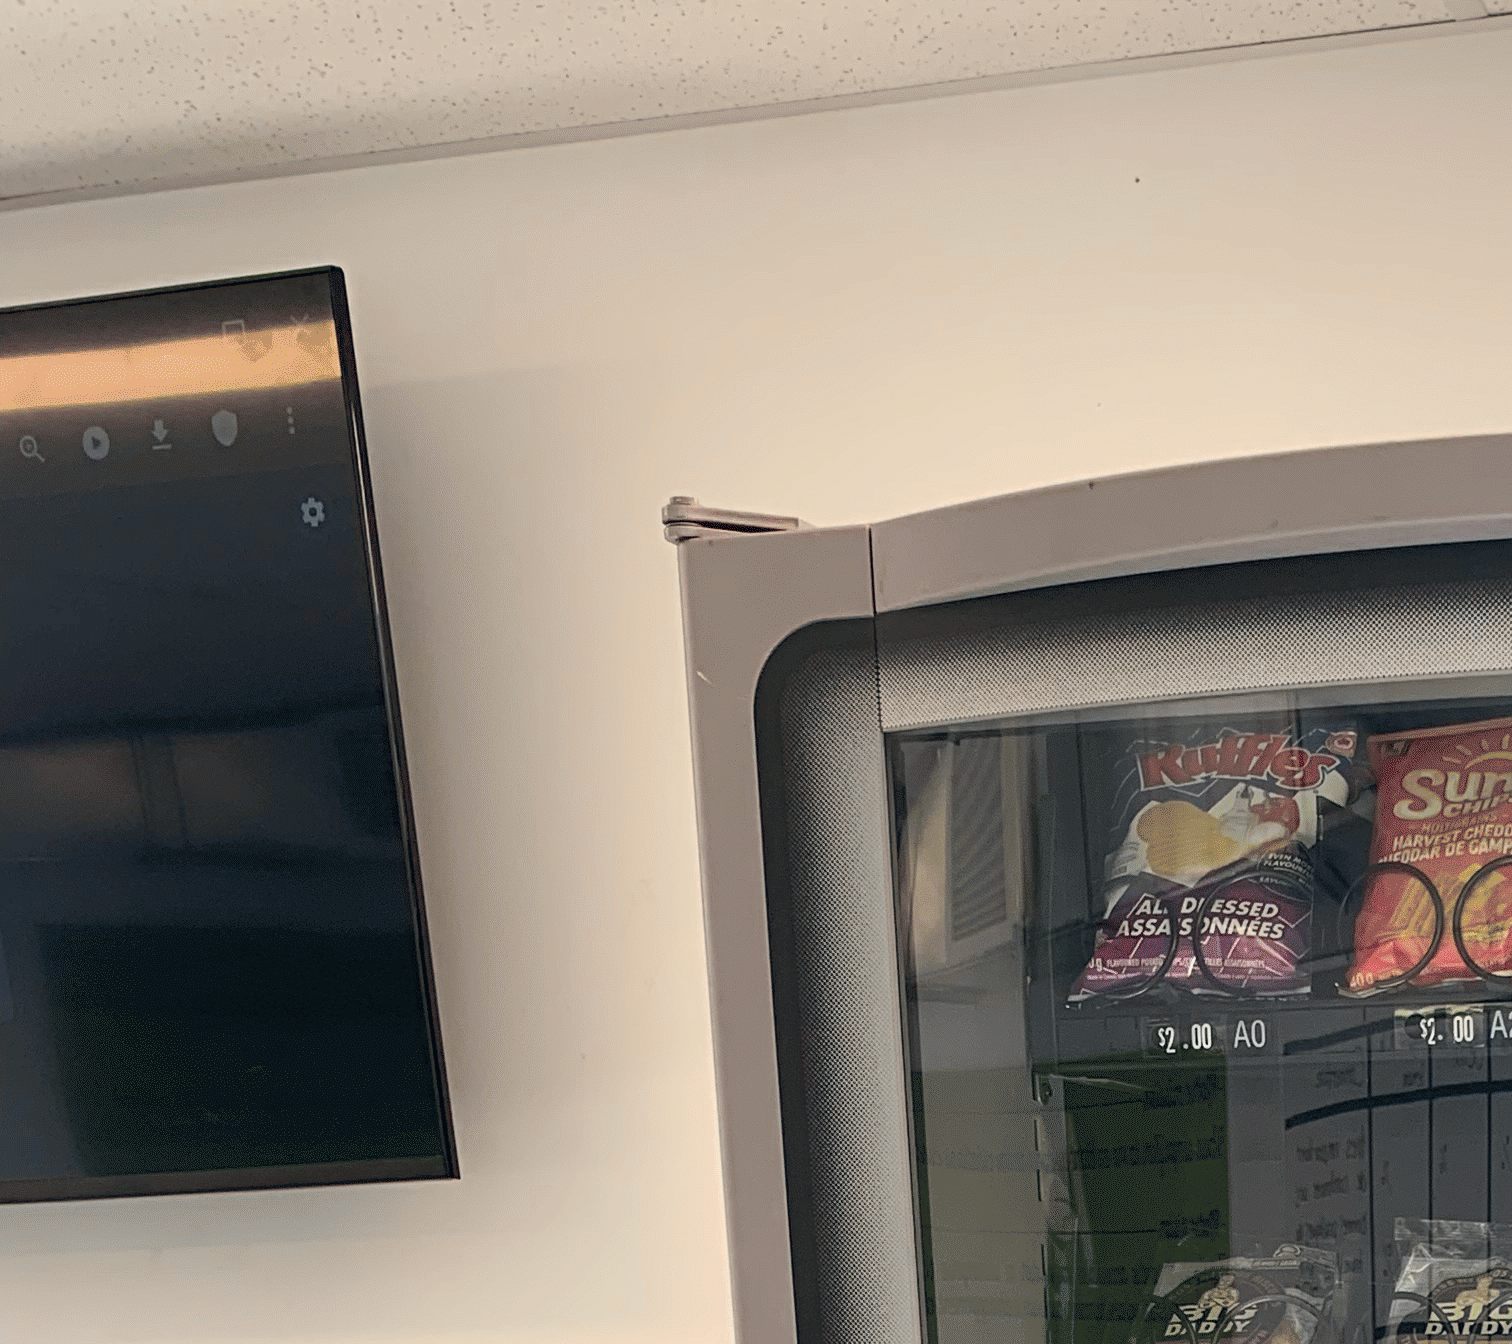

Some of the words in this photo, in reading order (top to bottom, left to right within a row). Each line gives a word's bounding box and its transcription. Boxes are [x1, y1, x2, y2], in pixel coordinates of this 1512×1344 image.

[1137, 731, 1341, 791] Ruffles
[1392, 830, 1461, 851] HARVEST
[1378, 844, 1440, 863] EDDAR
[1136, 898, 1170, 916] AL
[1181, 897, 1279, 918] DESSED
[1116, 917, 1286, 940] ASSASNNÉES
[1158, 1023, 1212, 1053] $2.00
[1234, 1019, 1266, 1048] A0
[1164, 1320, 1252, 1337] DADY
